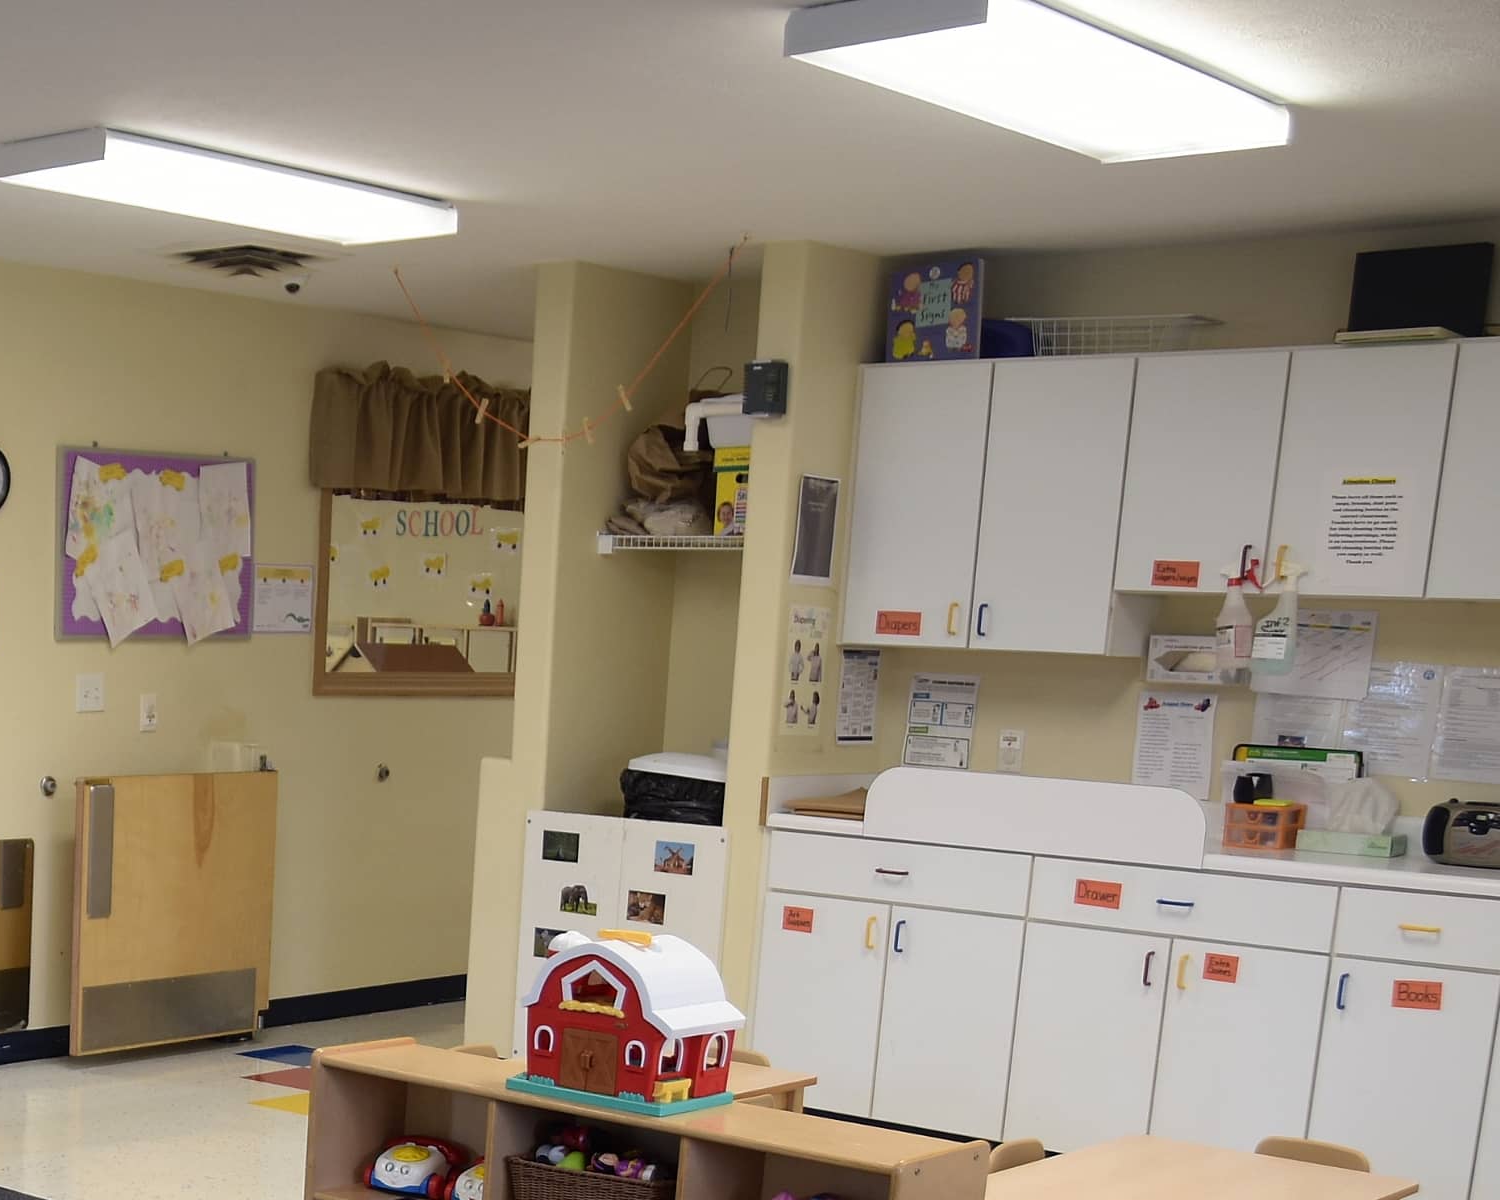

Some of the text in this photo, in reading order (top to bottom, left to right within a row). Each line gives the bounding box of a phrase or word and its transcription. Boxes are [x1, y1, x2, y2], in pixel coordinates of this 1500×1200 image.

[923, 293, 947, 304] First
[395, 506, 485, 537] SCHOOL
[878, 613, 918, 631] Diapers
[1077, 881, 1119, 903] Drawer
[1397, 981, 1438, 1003] Books
